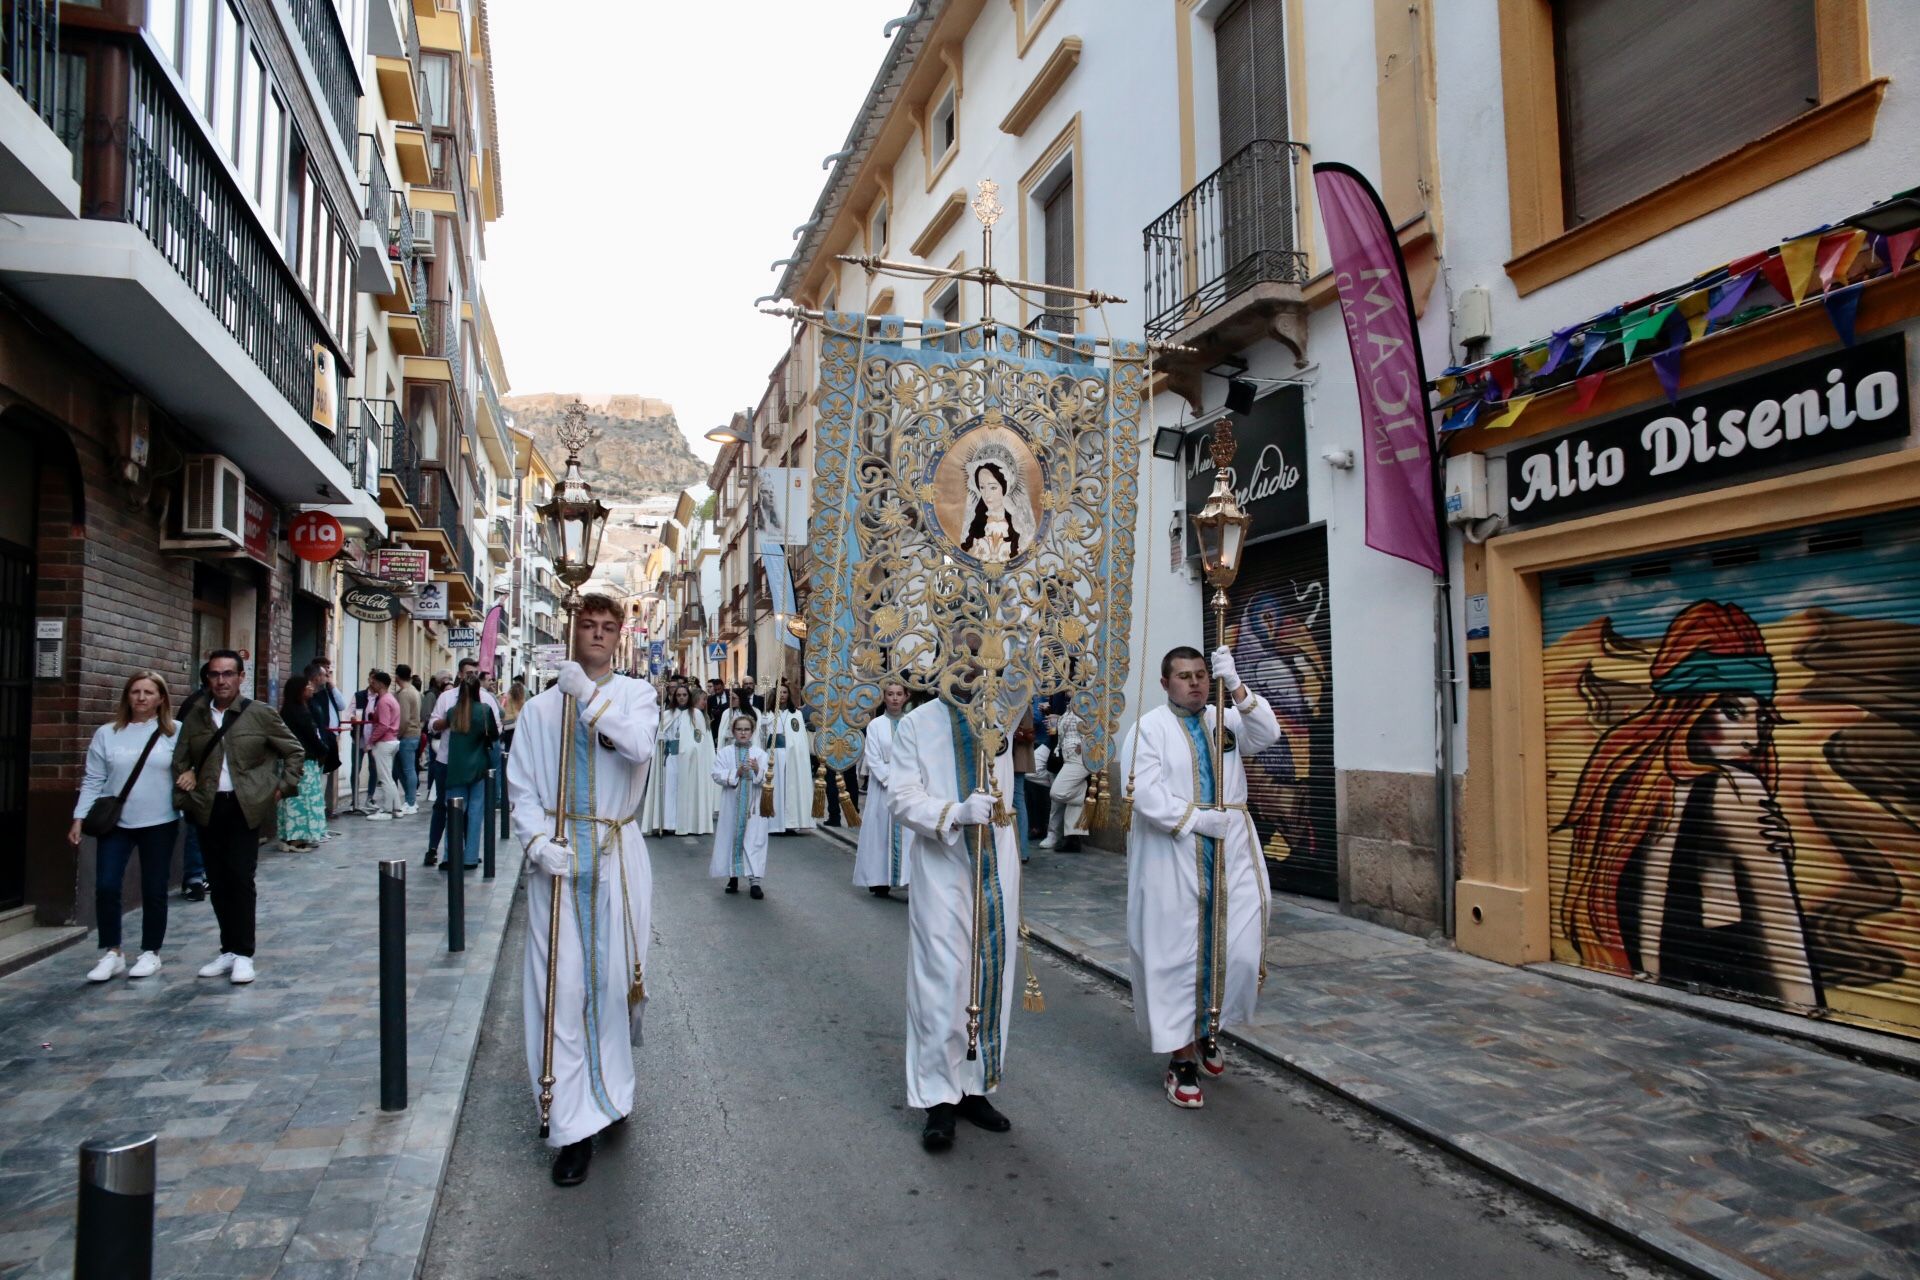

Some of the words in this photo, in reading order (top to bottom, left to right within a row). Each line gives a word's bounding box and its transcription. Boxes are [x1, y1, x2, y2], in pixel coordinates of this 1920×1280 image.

[1510, 440, 1624, 511] Alto
[1641, 368, 1899, 476] Disenio
[295, 516, 336, 541] ria
[419, 601, 440, 609] CGA
[449, 629, 474, 640] LANAS
